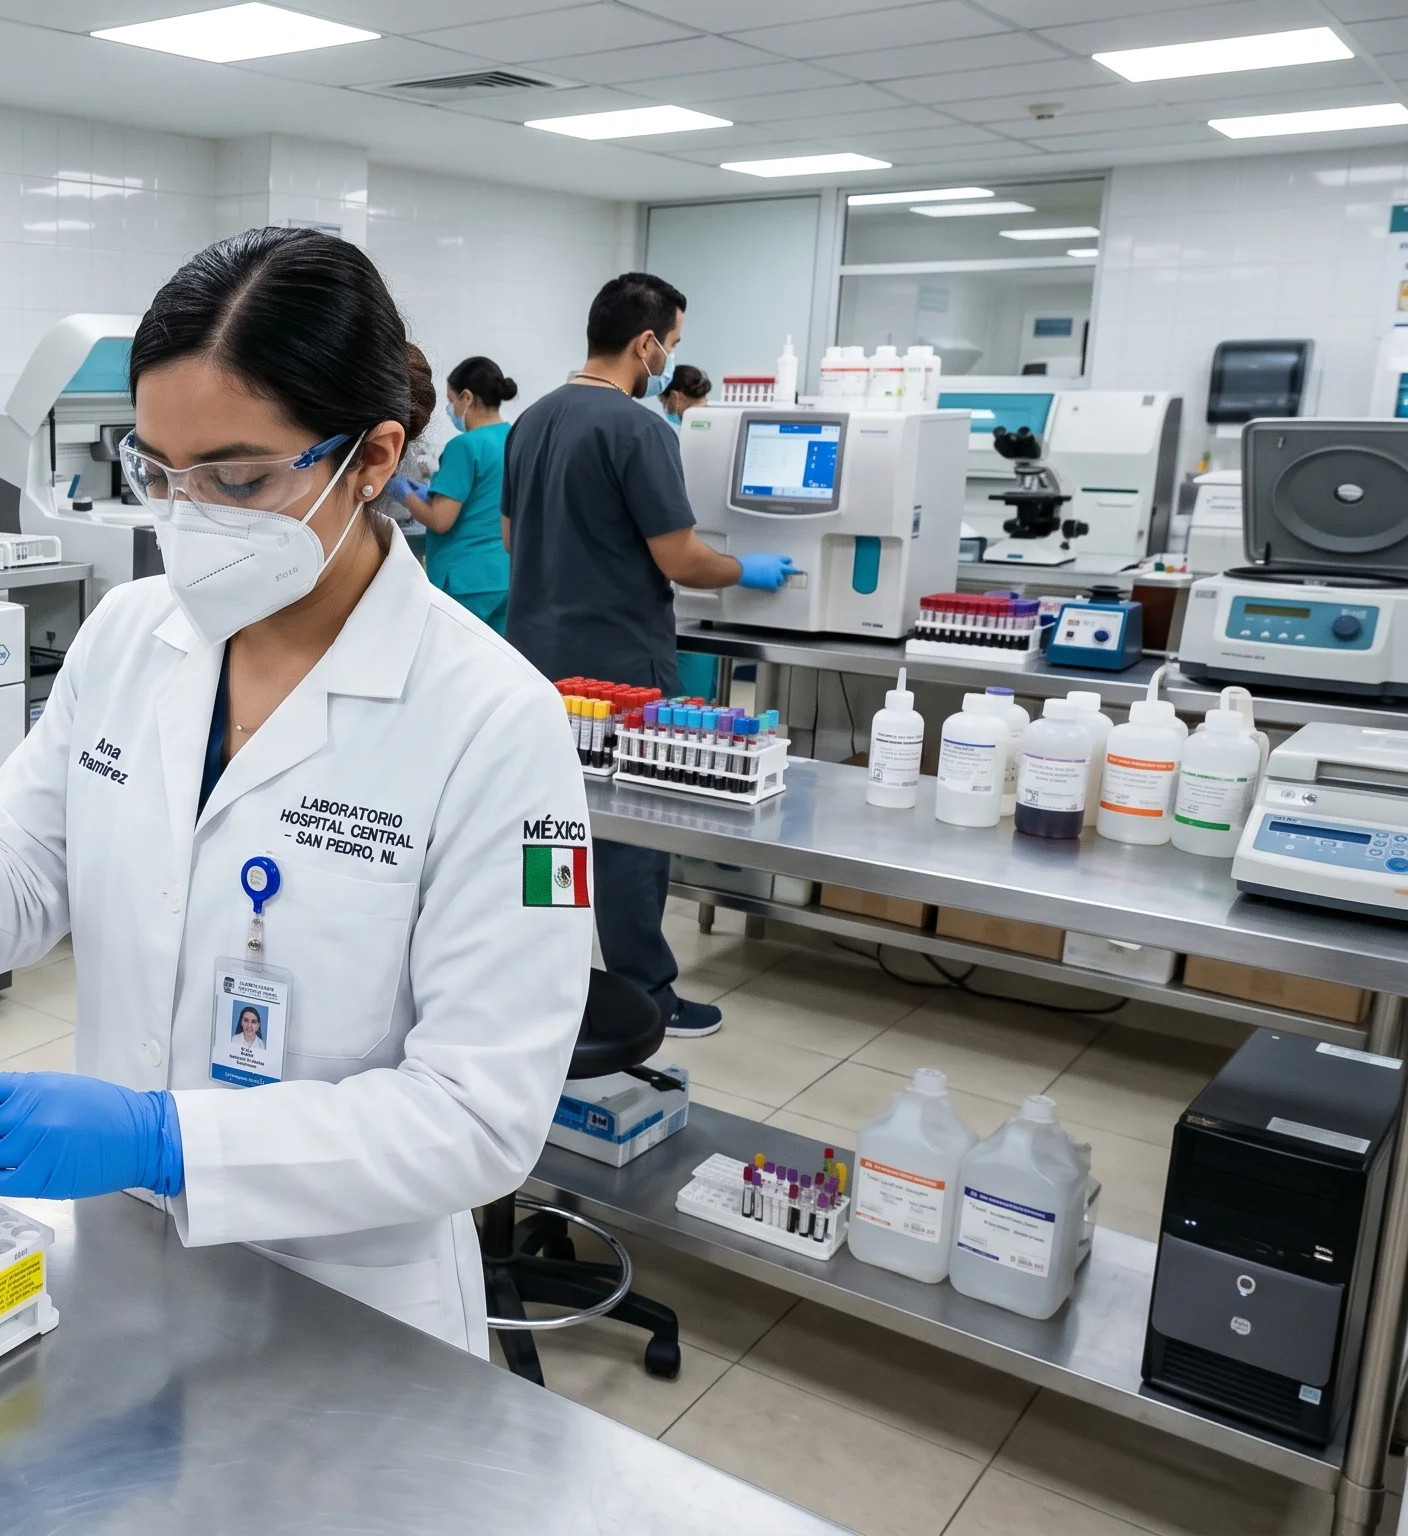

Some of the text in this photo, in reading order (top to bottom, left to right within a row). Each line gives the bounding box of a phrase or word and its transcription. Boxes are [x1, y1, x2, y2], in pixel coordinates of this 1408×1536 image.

[94, 737, 122, 761] Ana
[78, 751, 129, 785] Ramírez
[279, 808, 414, 849] HOSPITAL CENTRAL
[300, 795, 404, 829] LABORATORIO
[524, 814, 585, 841] MÉXICO
[295, 831, 324, 851] SAN
[326, 838, 375, 863] PEDRO,
[379, 850, 399, 866] NL
